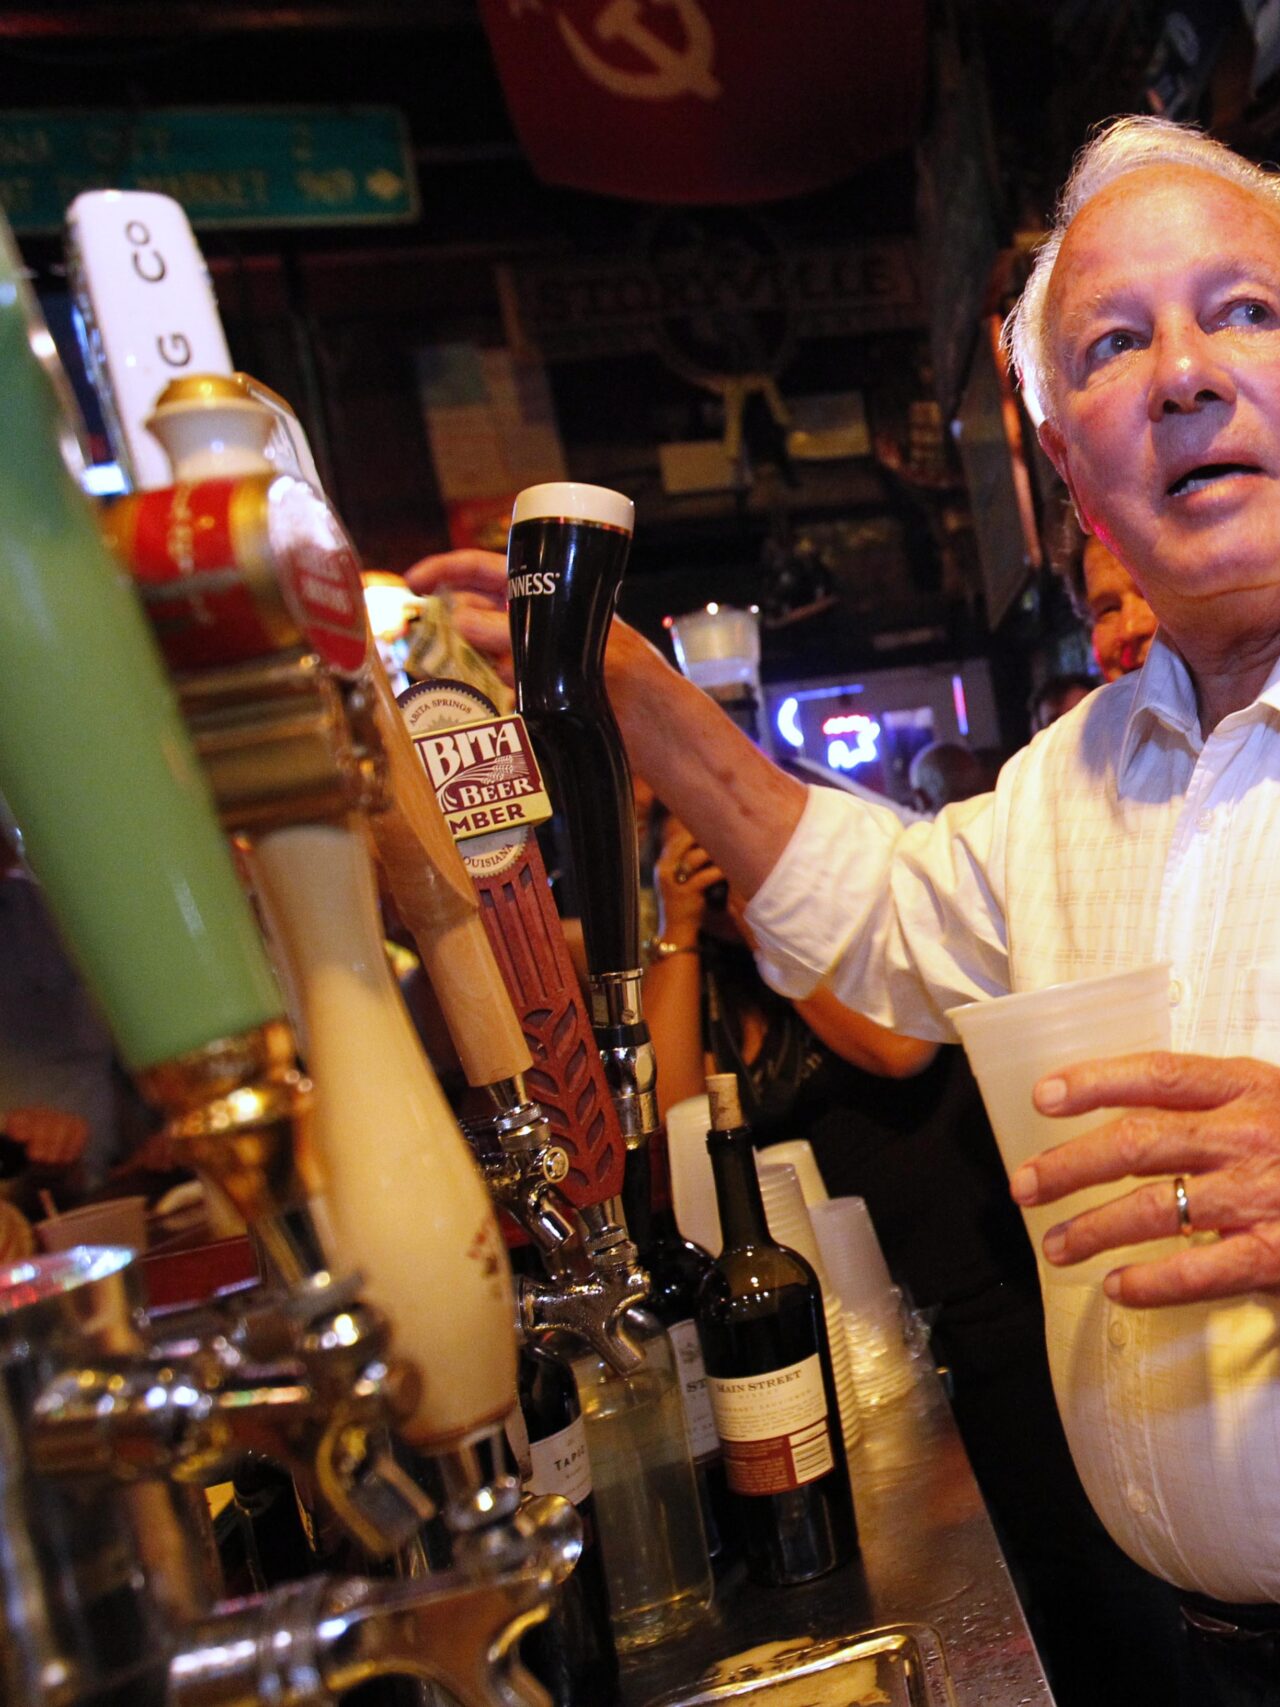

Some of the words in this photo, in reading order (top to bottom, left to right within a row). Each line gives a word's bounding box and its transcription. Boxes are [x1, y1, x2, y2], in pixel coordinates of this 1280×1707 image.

[410, 703, 432, 727] ABITA
[431, 698, 473, 714] SPRINGS
[414, 722, 523, 790] BITA
[459, 777, 535, 808] BEER
[448, 803, 527, 836] MBER
[462, 842, 514, 869] OUISIANA
[716, 1384, 746, 1394] MAIN
[748, 1369, 803, 1390] STREET
